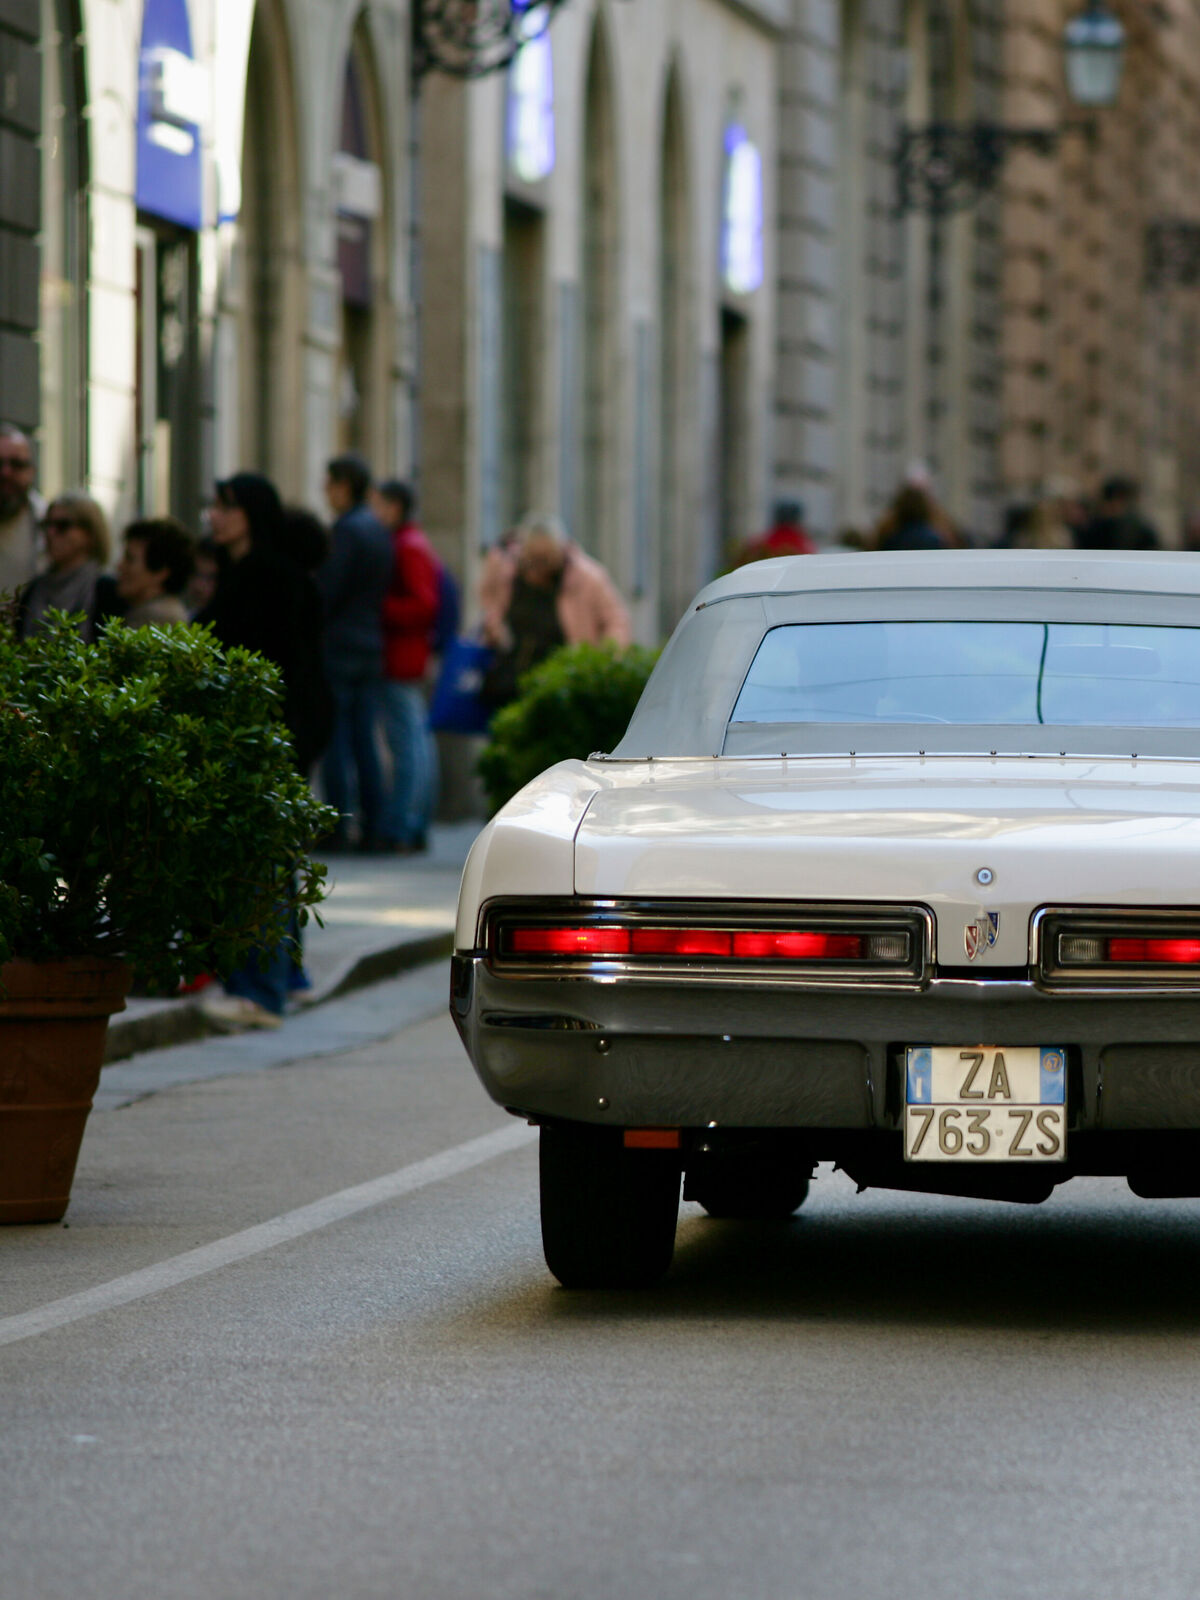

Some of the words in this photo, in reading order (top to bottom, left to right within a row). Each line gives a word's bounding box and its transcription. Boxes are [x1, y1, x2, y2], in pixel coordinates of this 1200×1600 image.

[915, 1077, 922, 1098] I
[959, 1052, 1011, 1099] ZA
[909, 1108, 991, 1156] 763
[1008, 1109, 1061, 1156] ZS
